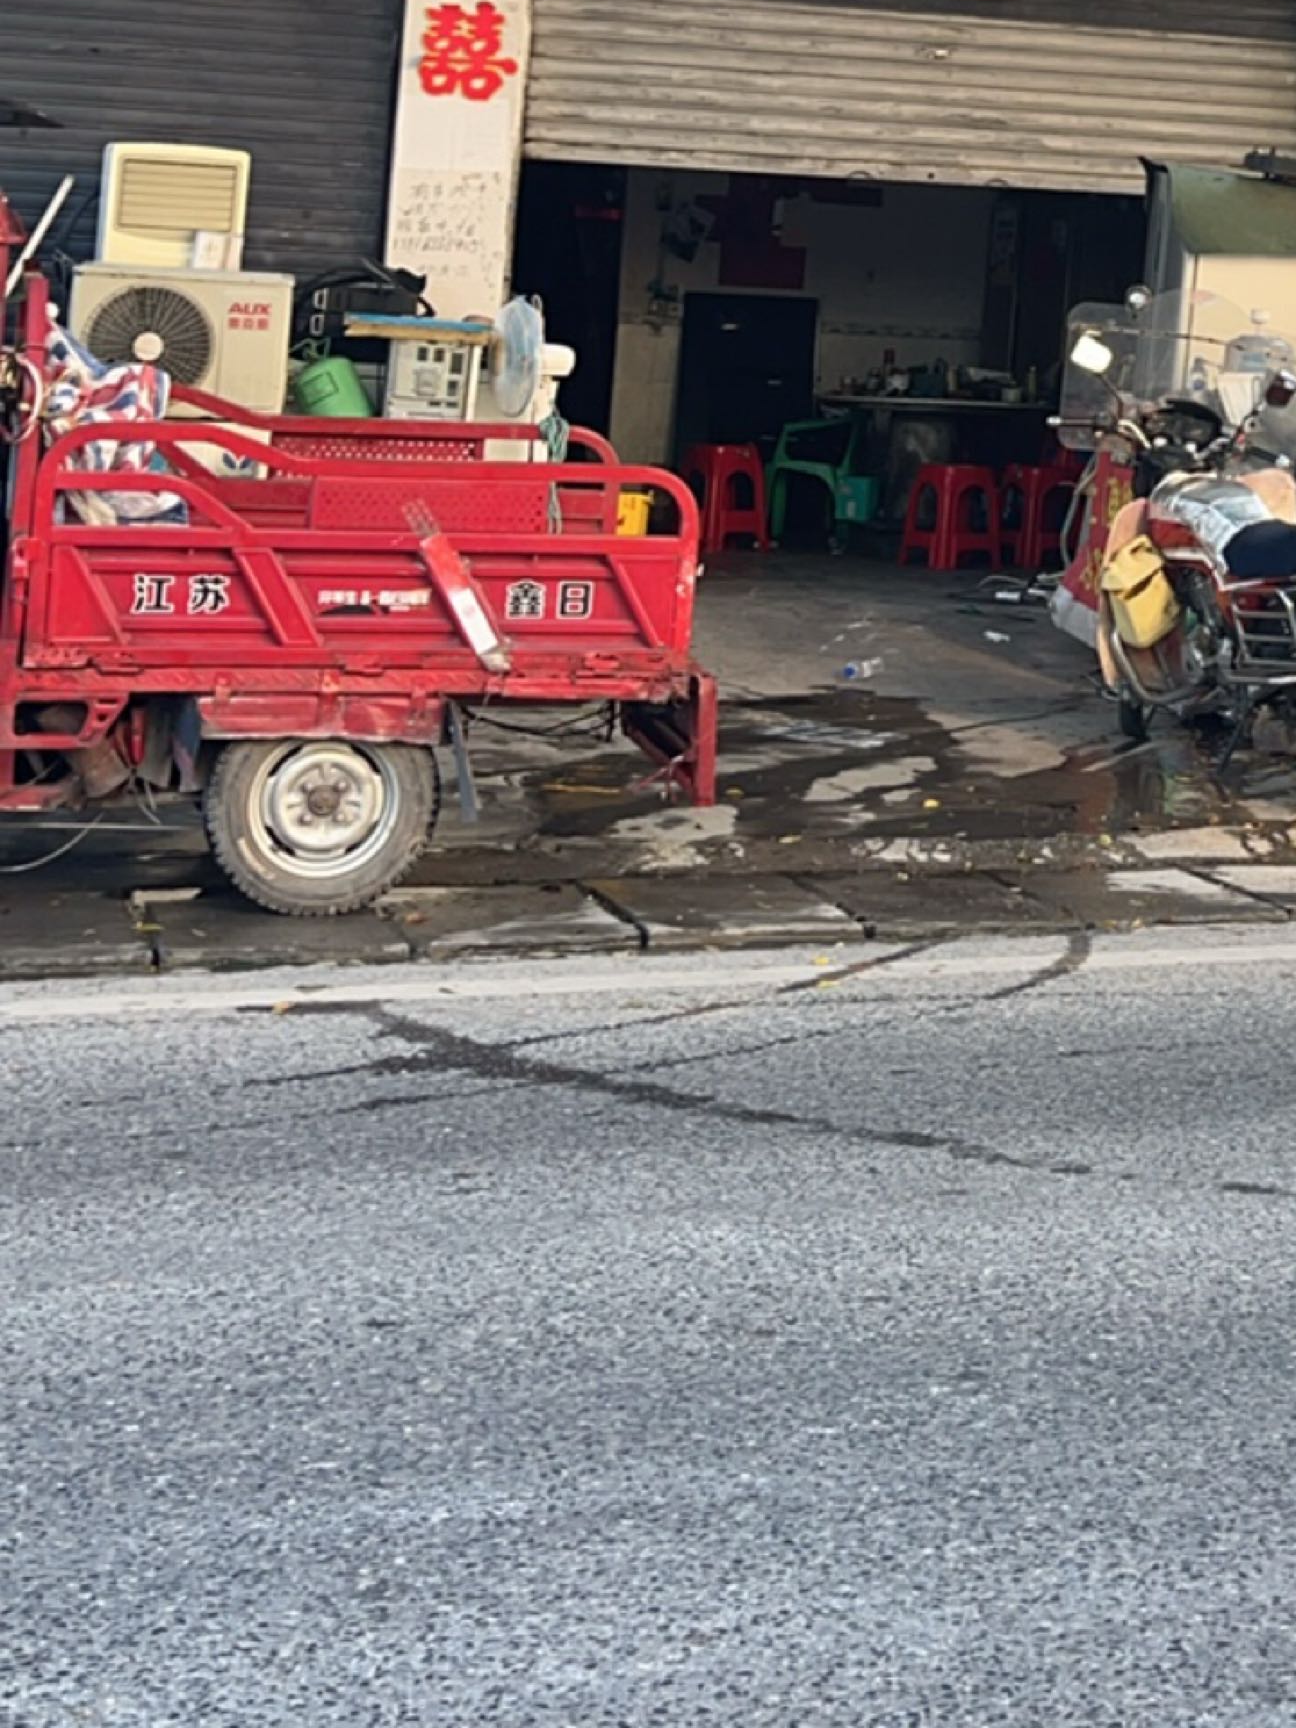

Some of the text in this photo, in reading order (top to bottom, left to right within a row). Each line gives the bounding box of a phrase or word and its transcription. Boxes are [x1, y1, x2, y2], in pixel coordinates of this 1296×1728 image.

[228, 302, 272, 315] AUX
[131, 574, 229, 615] 江苏
[505, 578, 594, 619] 鑫日
